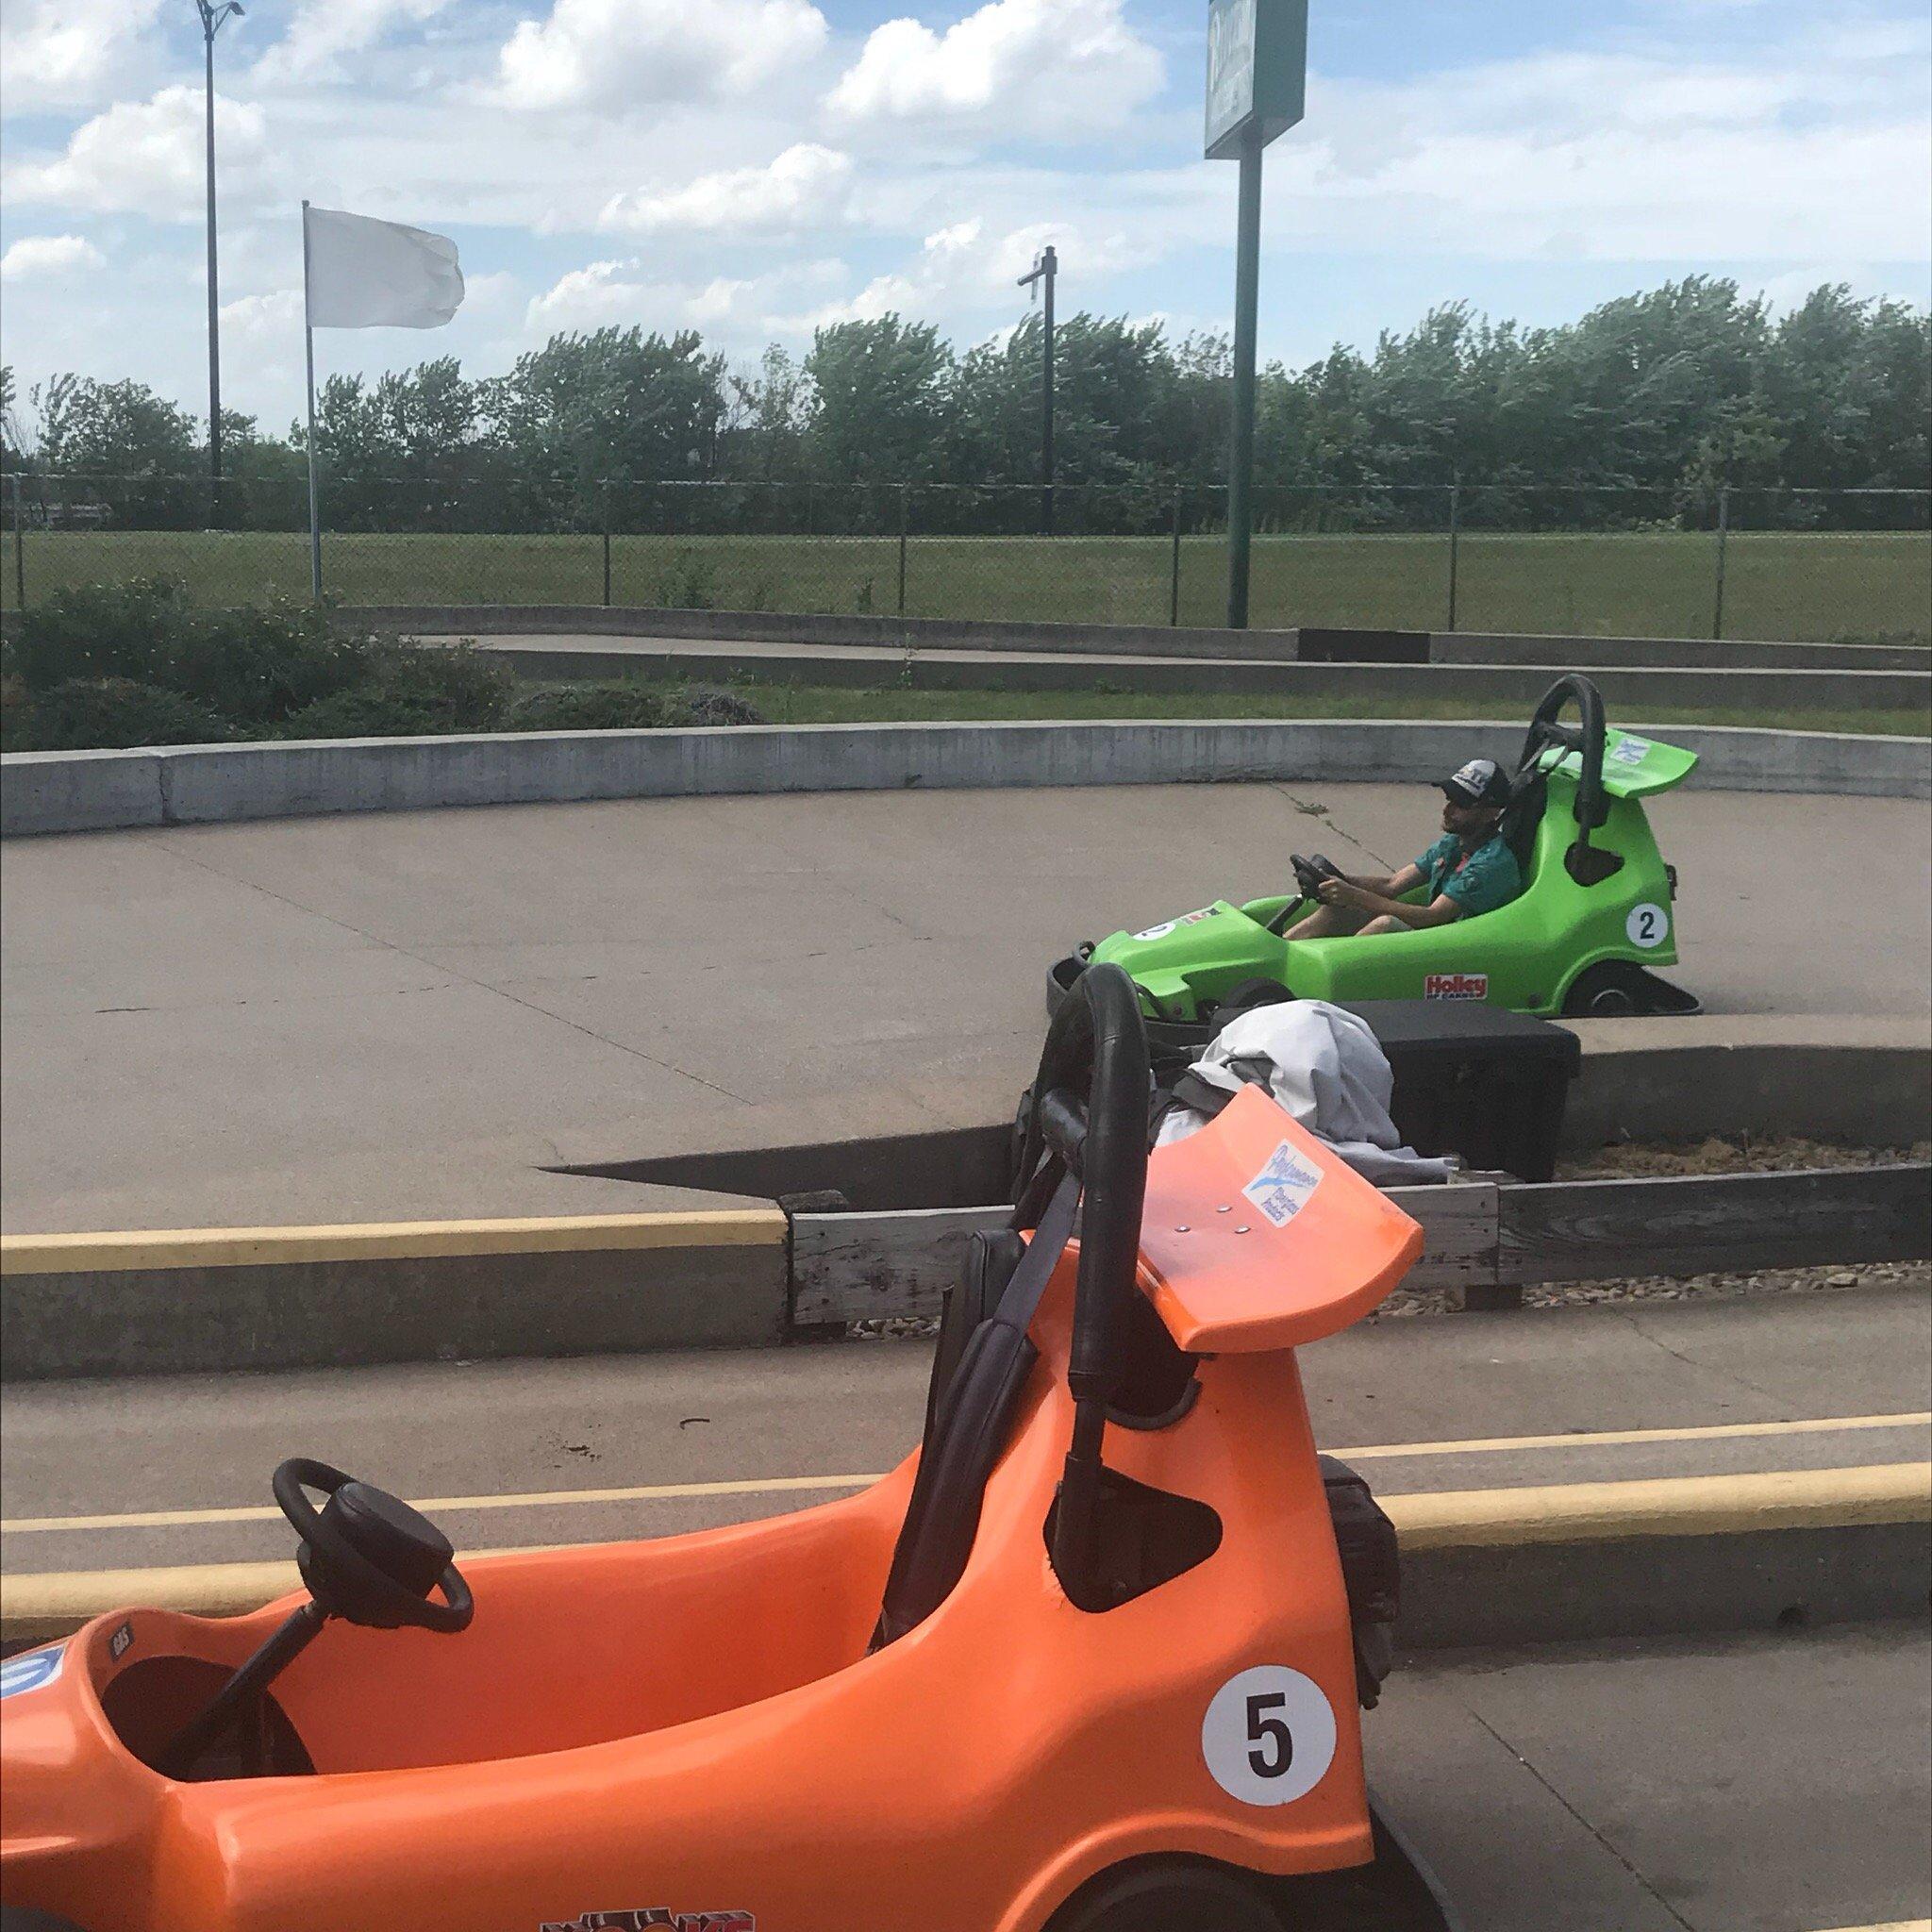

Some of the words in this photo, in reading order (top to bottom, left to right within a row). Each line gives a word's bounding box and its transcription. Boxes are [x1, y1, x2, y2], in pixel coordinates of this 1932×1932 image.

[1640, 911, 1655, 940] 2
[1427, 975, 1487, 998] Holley
[1246, 1691, 1293, 1778] 5
